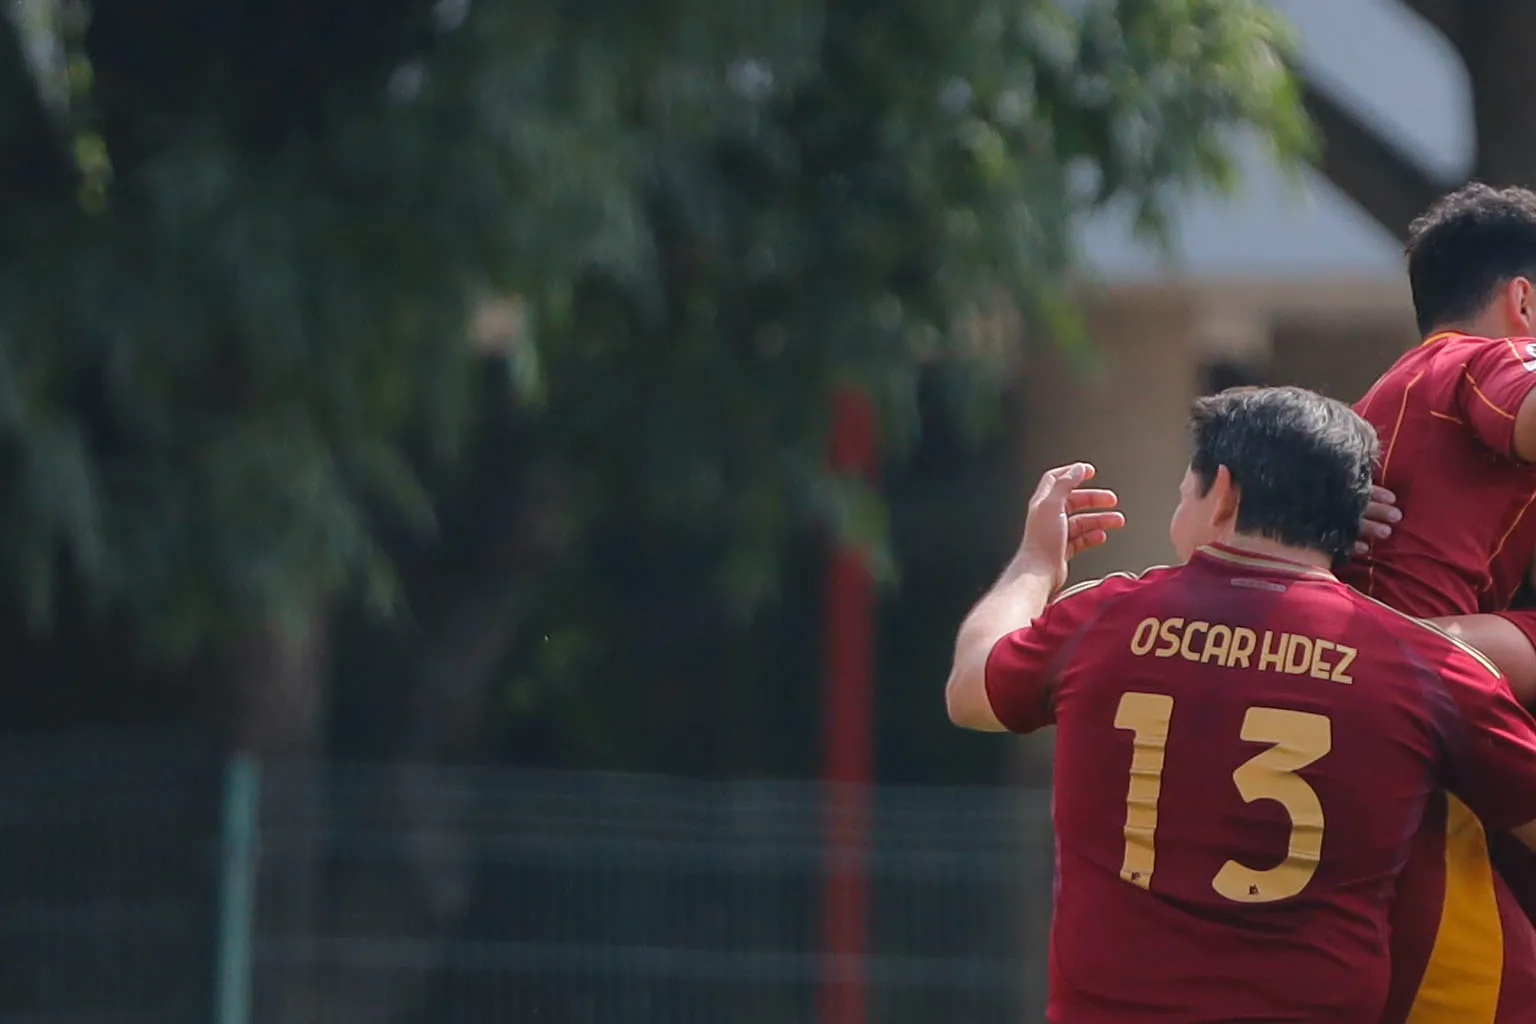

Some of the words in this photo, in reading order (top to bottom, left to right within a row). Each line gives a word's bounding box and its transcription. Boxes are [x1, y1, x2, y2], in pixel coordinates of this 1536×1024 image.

[1130, 617, 1256, 668] OSCAR
[1258, 630, 1357, 684] HDEZ
[1113, 691, 1332, 903] 13
